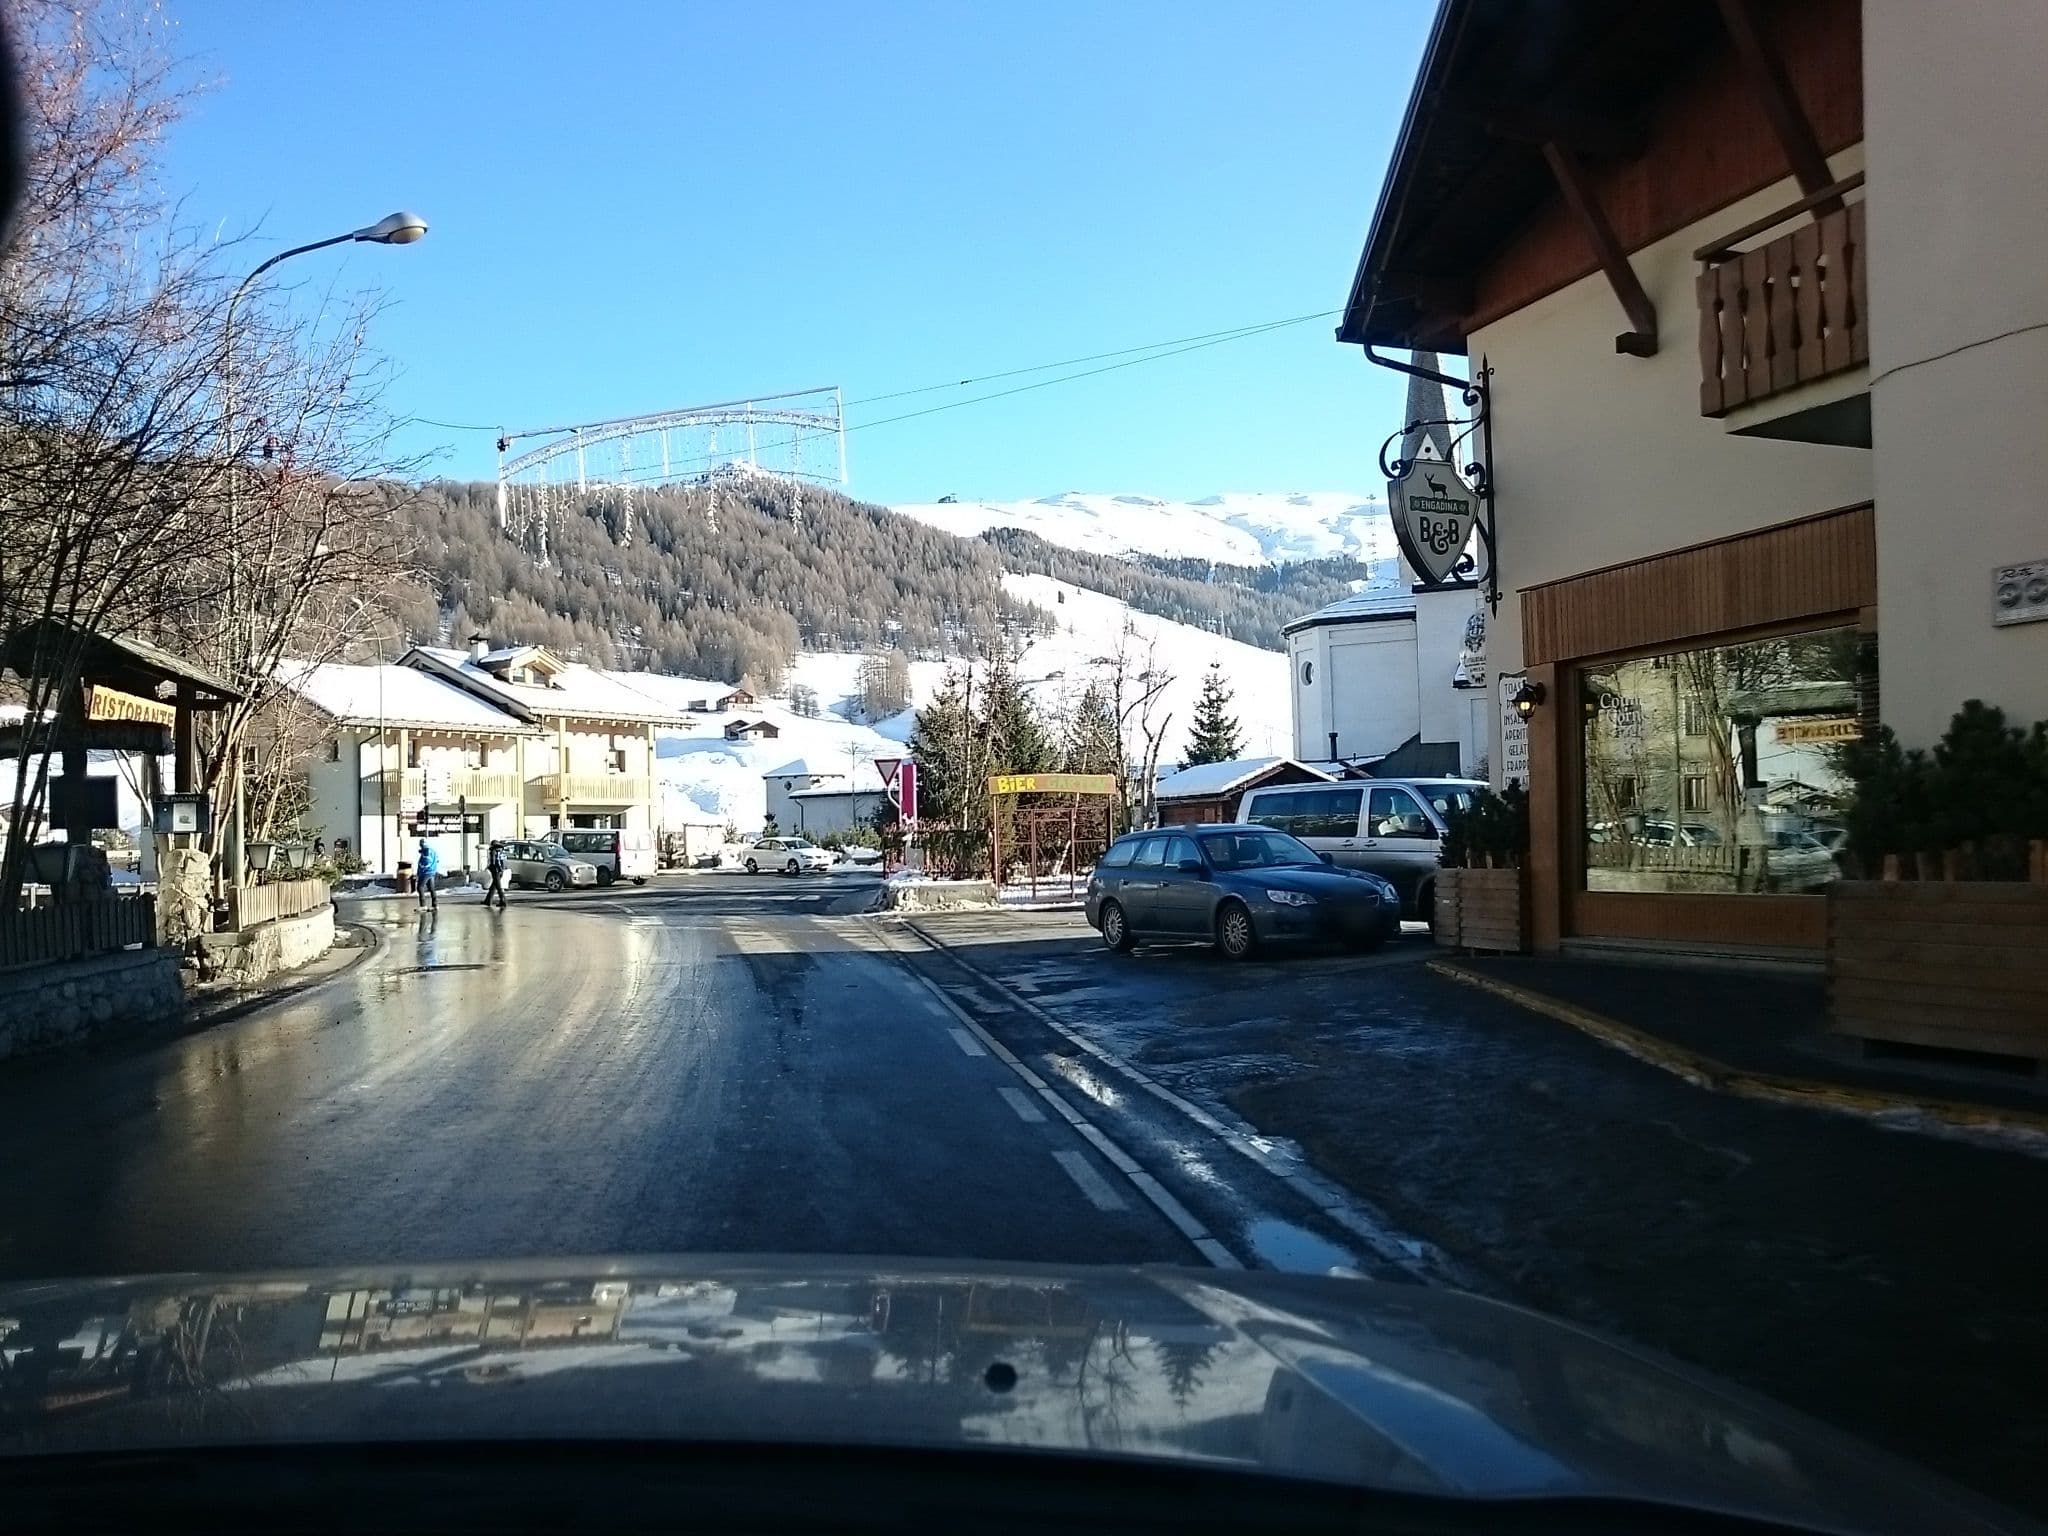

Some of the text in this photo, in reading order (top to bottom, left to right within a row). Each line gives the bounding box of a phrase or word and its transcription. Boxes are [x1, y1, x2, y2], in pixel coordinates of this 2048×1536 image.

[1421, 500, 1458, 512] ENGADINA
[1420, 516, 1459, 555] B&B
[1504, 683, 1524, 696] TOAS
[92, 693, 174, 725] RISTORANTE
[1504, 728, 1528, 741] APERIT
[1508, 743, 1528, 756] GELAT
[1506, 760, 1528, 772] FRAPP
